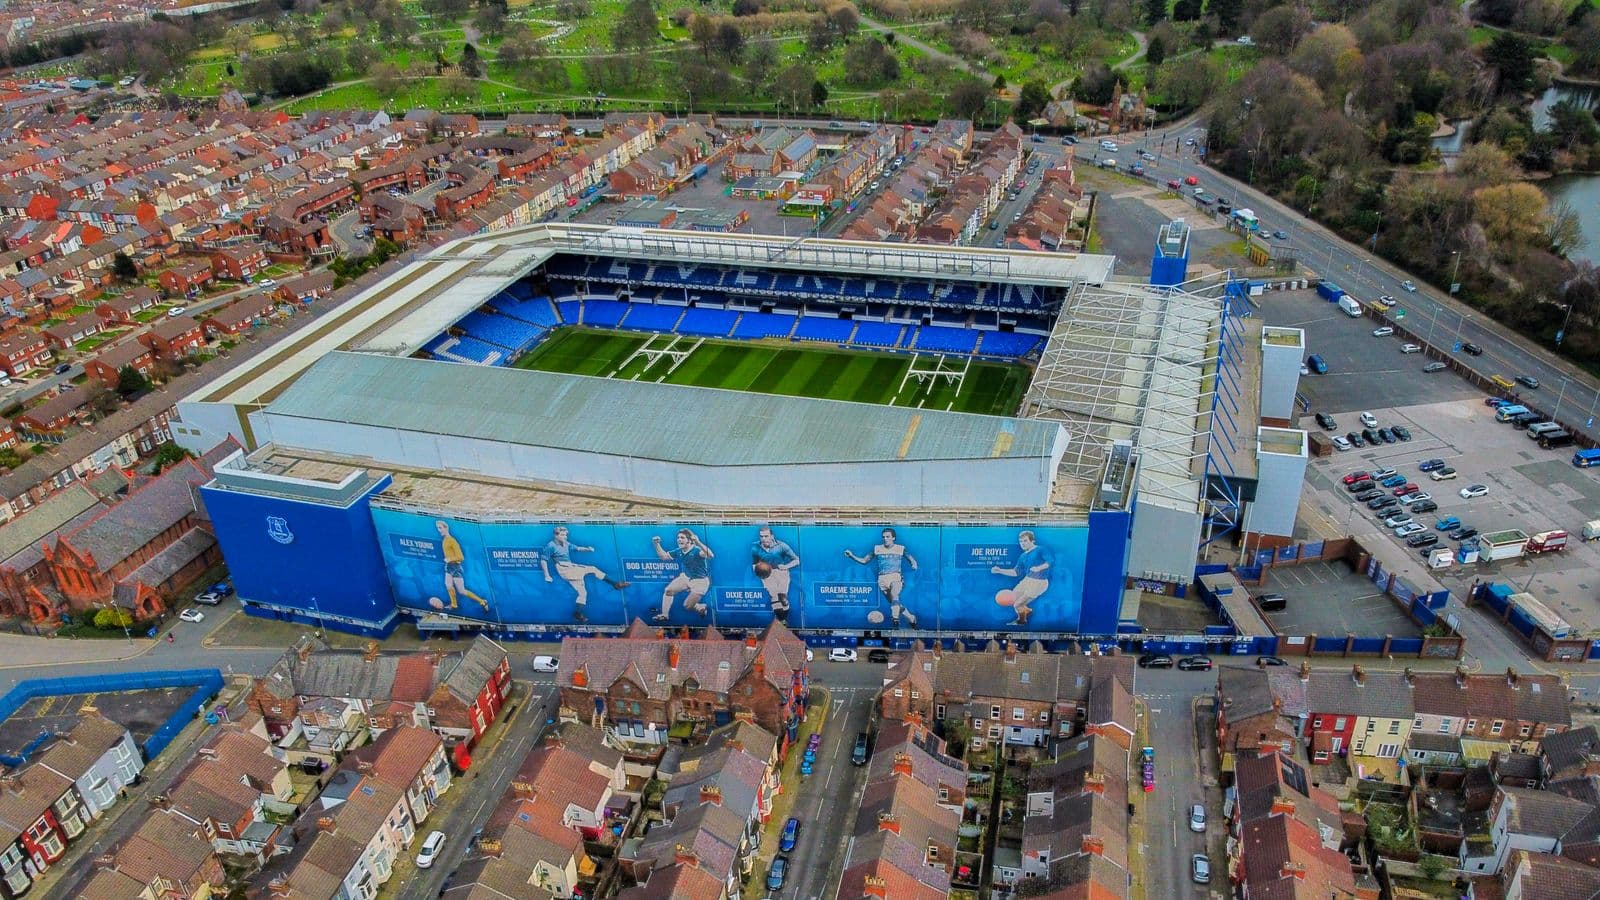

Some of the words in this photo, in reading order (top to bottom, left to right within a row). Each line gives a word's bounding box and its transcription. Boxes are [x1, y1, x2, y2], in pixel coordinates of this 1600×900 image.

[400, 538, 415, 547] ALEX
[414, 541, 434, 550] YOUNG
[492, 551, 510, 559] DAVE
[511, 551, 539, 559] HICKSON
[971, 548, 984, 556] JOE
[985, 548, 1008, 556] ROYLE
[626, 562, 640, 570] BOB
[641, 562, 679, 570] LATCHFORD
[820, 586, 848, 594] GRAEME
[849, 586, 873, 594] SHARP
[725, 591, 743, 599] DIXIE
[744, 591, 763, 599] DEAN
